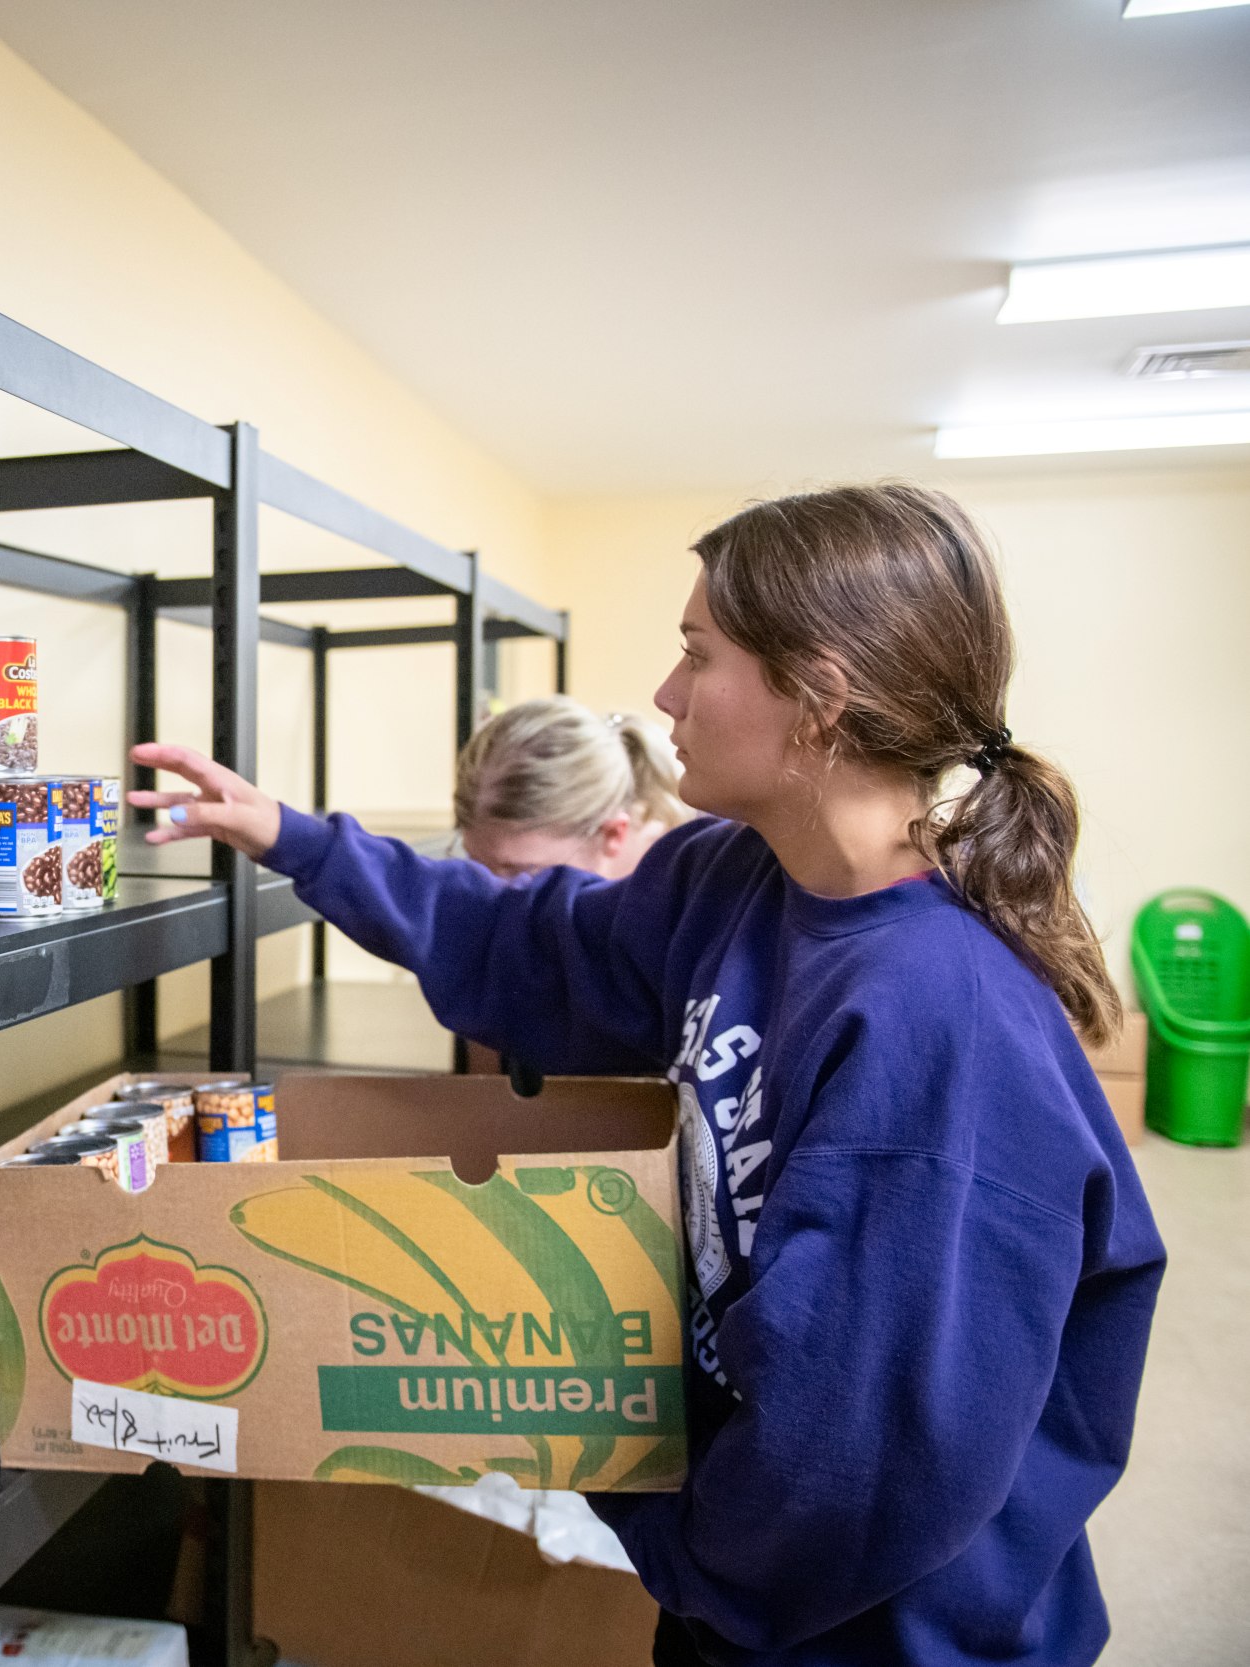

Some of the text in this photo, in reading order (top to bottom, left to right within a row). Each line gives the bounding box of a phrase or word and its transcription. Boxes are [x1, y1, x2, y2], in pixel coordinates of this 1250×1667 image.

[108, 1276, 187, 1308] Quality
[57, 1310, 246, 1352] Del Monte
[350, 1310, 653, 1357] BANANAS
[399, 1377, 658, 1423] Premium
[138, 1424, 221, 1459] Fruit
